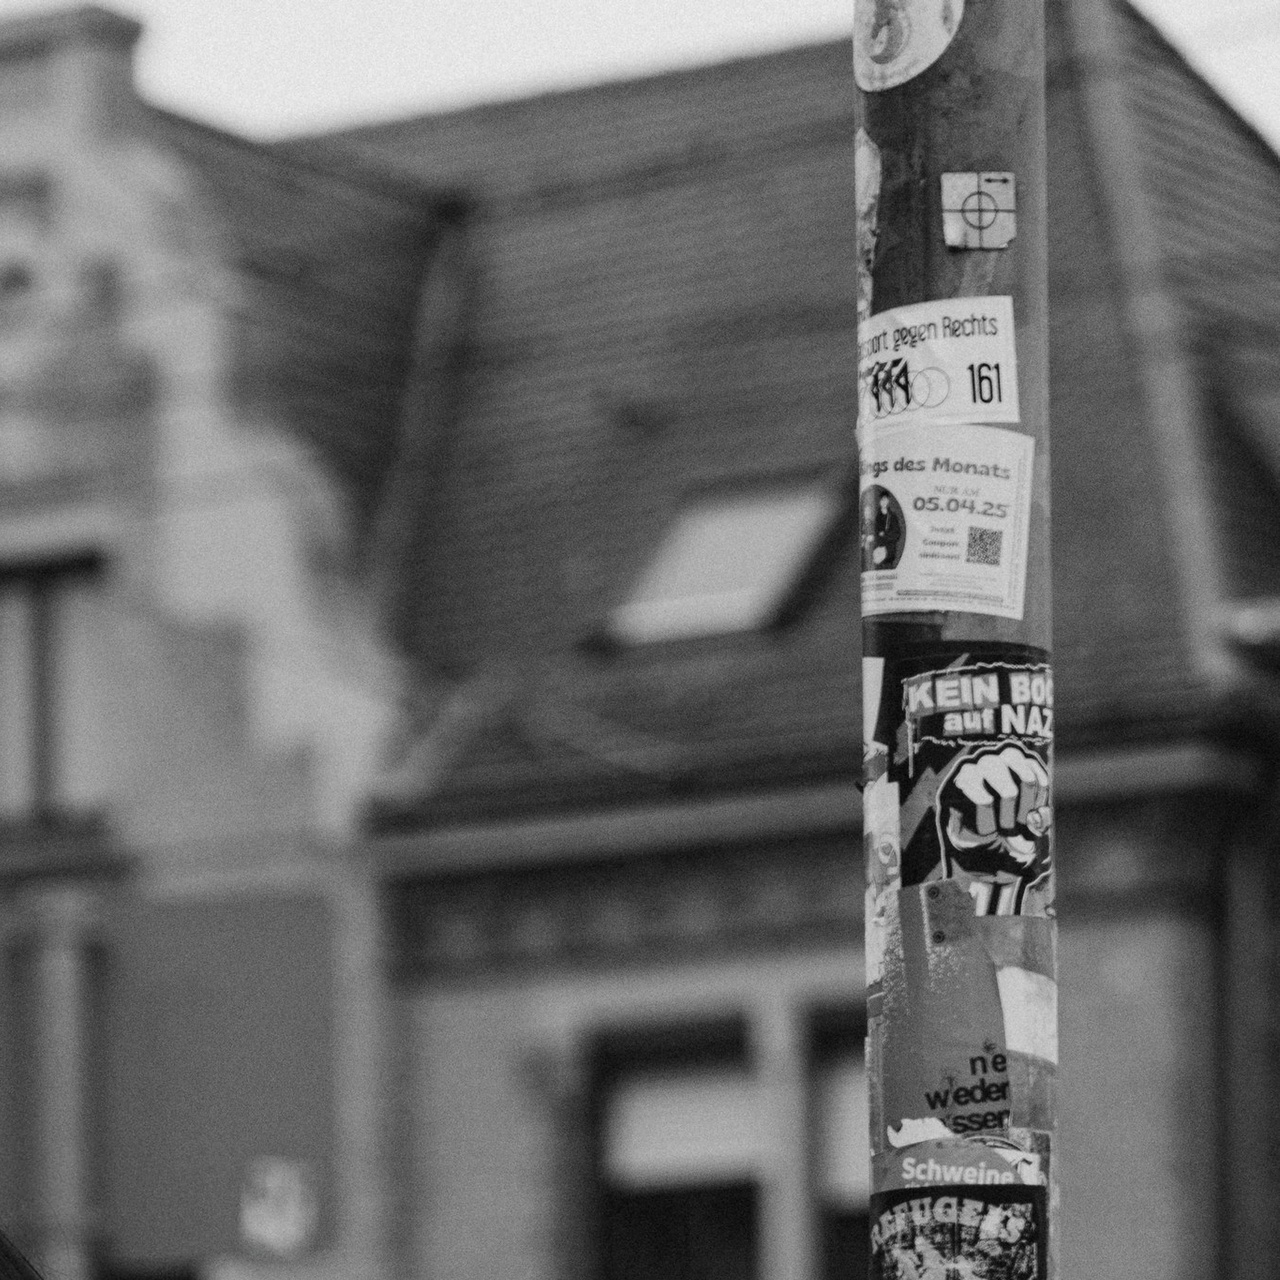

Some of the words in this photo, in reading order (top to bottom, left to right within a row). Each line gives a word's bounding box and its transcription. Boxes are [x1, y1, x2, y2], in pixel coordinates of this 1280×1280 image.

[893, 322, 937, 352] gegen
[941, 313, 999, 339] Rechts
[967, 362, 1002, 404] 161
[893, 456, 926, 473] des
[932, 456, 1011, 480] Monats
[913, 496, 1010, 519] 05.04.25
[907, 673, 1001, 713] KEIN
[943, 707, 995, 736] auf
[901, 1156, 1015, 1184] Schweine
[871, 1195, 1027, 1255] REFUGES
